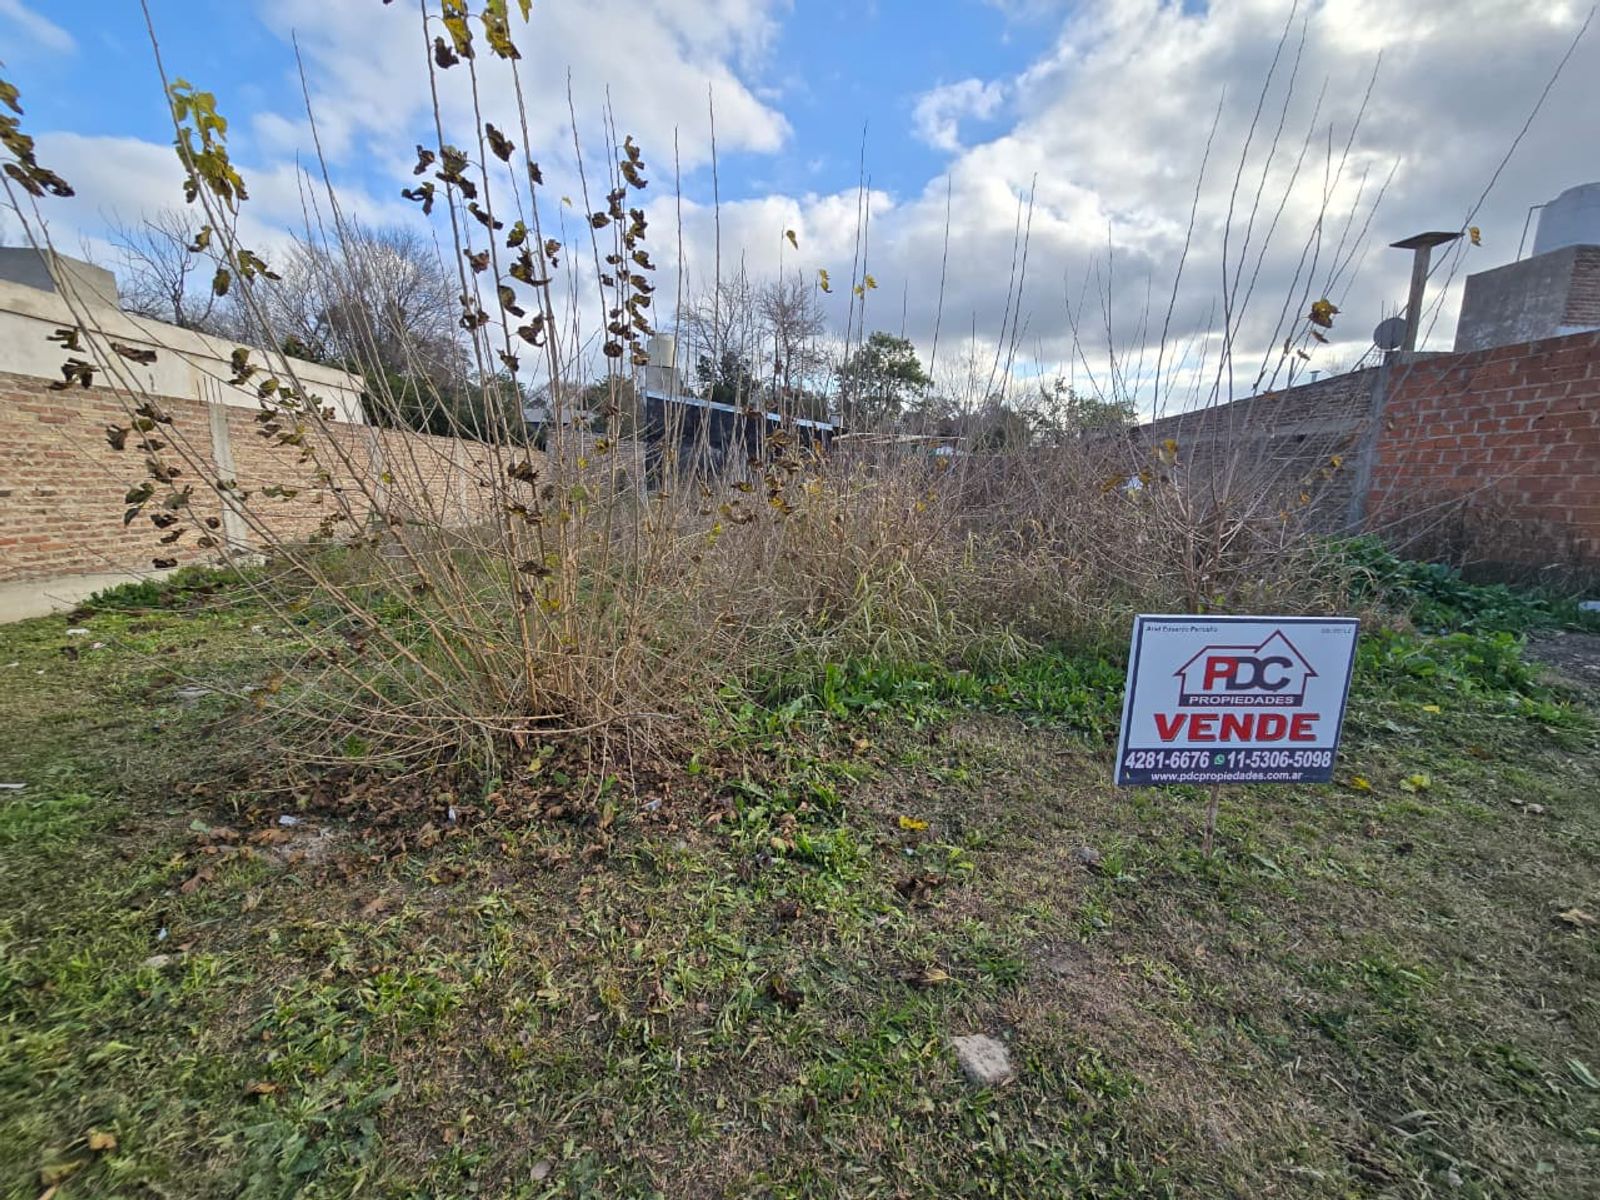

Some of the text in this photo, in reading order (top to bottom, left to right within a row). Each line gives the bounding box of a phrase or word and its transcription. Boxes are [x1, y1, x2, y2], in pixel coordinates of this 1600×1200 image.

[1203, 656, 1294, 691] PDC
[1189, 696, 1294, 705] PROPIEDADES
[1154, 713, 1320, 742] VENDE
[1124, 751, 1331, 769] 4281-6676 11-5306-5098
[1151, 770, 1303, 782] www.pdcpropiedades.com.ar
